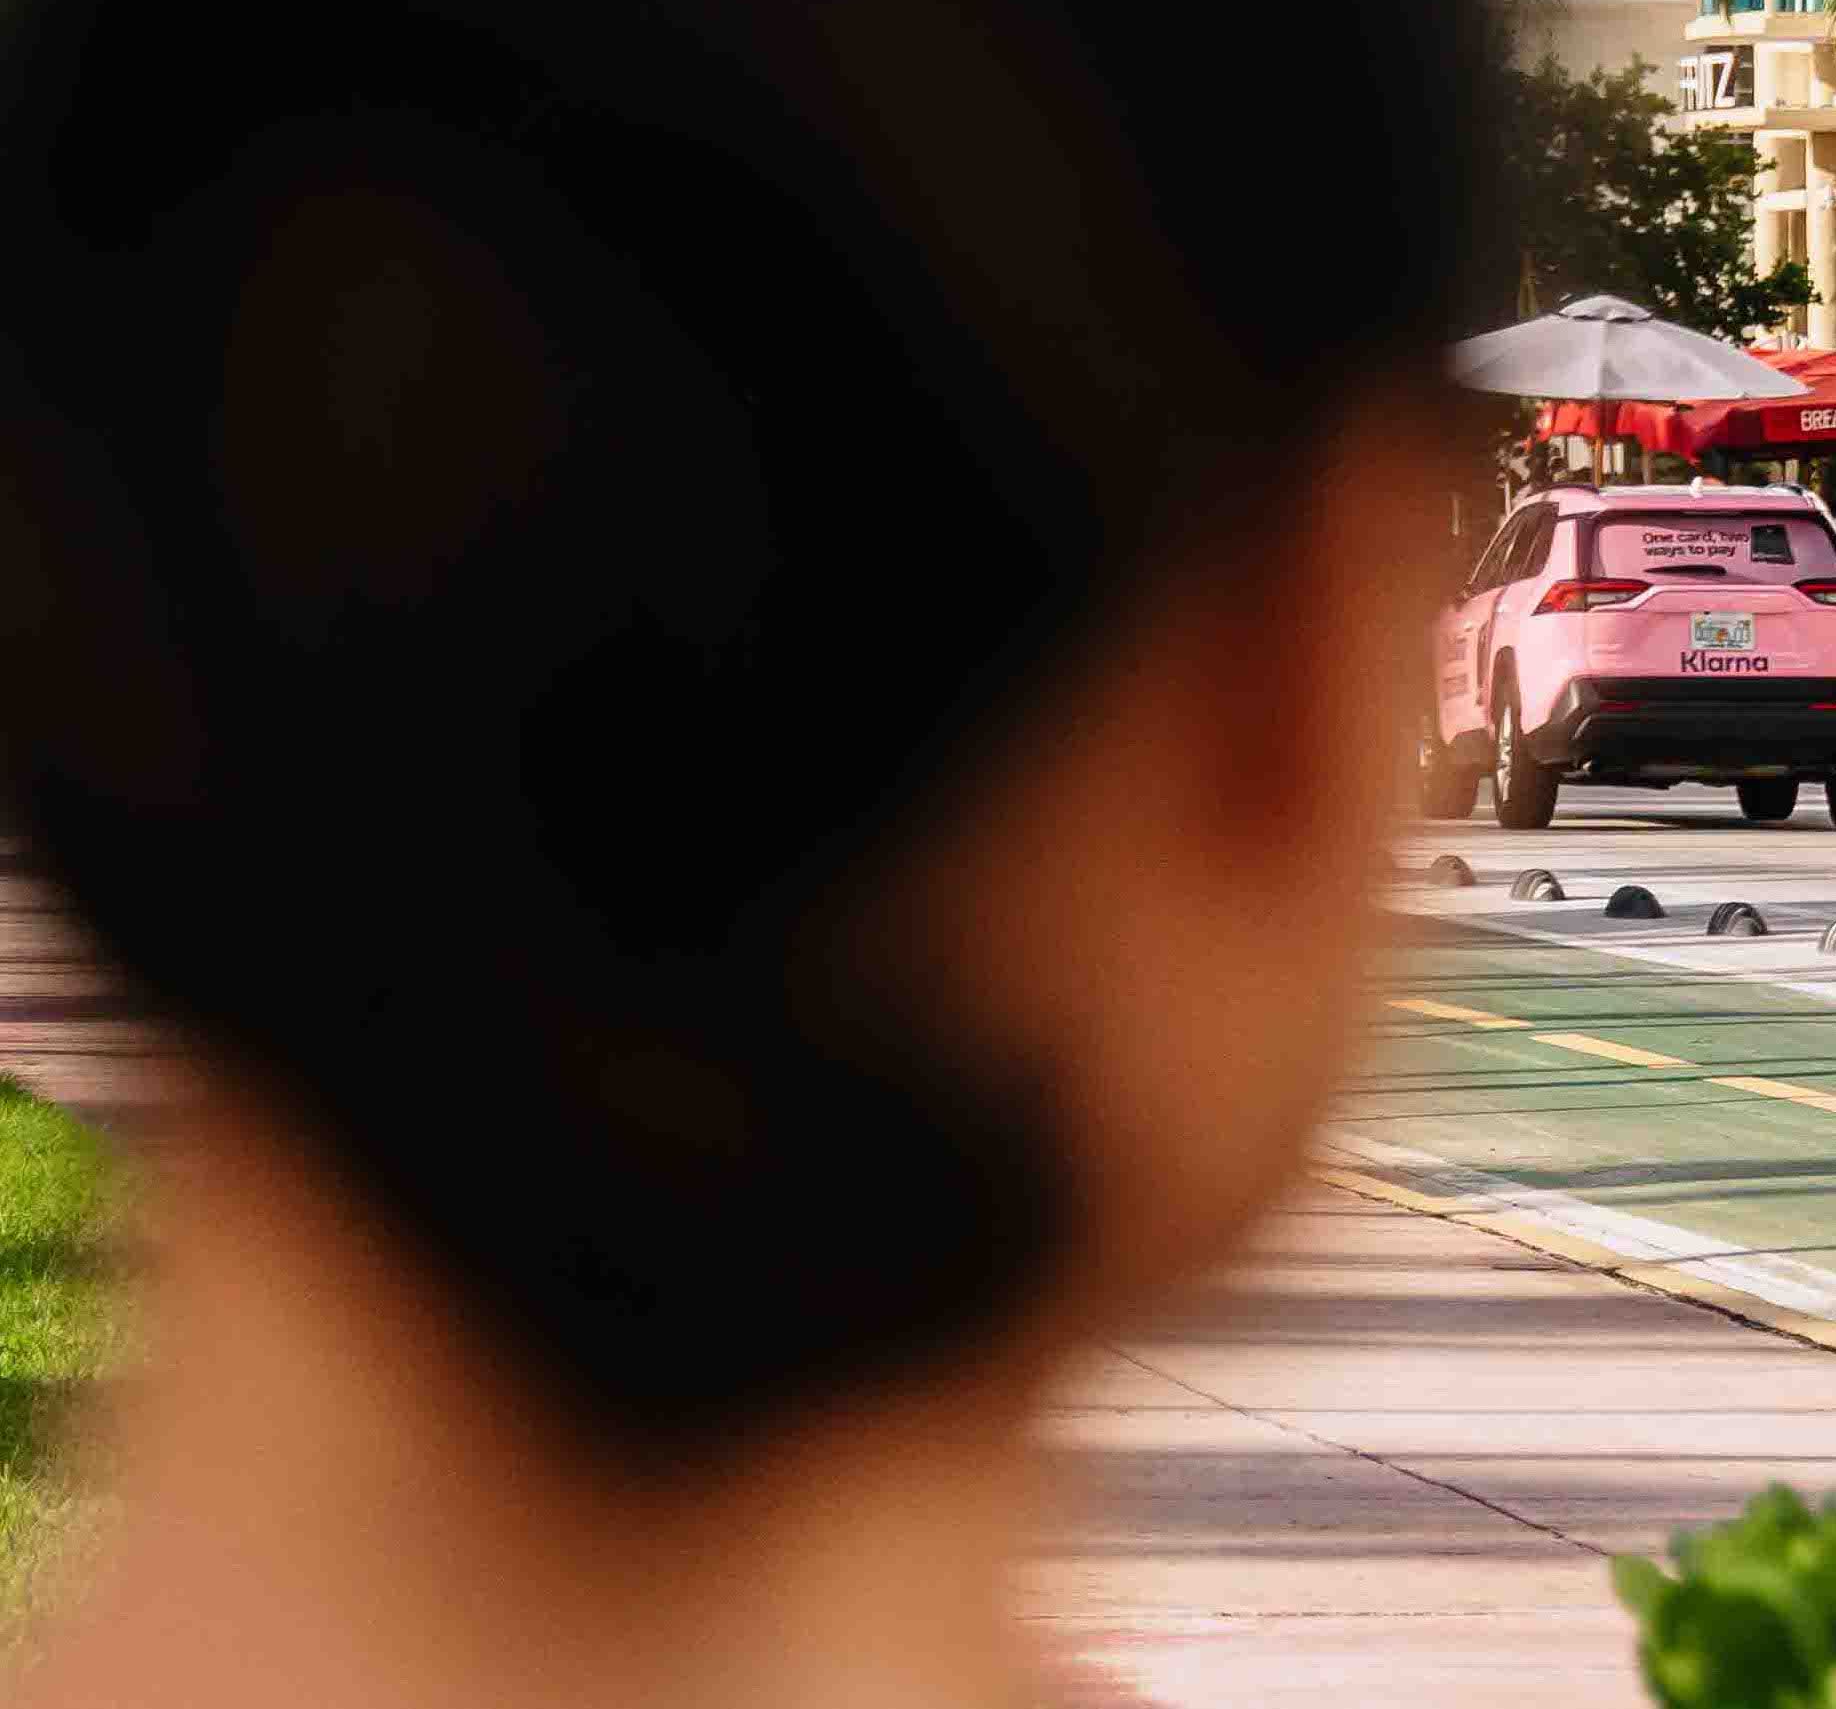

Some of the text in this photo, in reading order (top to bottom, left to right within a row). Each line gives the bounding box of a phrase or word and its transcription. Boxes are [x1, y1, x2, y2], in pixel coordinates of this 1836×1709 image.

[1642, 532, 1674, 544] One
[1687, 545, 1705, 555] to
[1707, 545, 1736, 558] pay
[1680, 651, 1770, 673] Klarna
